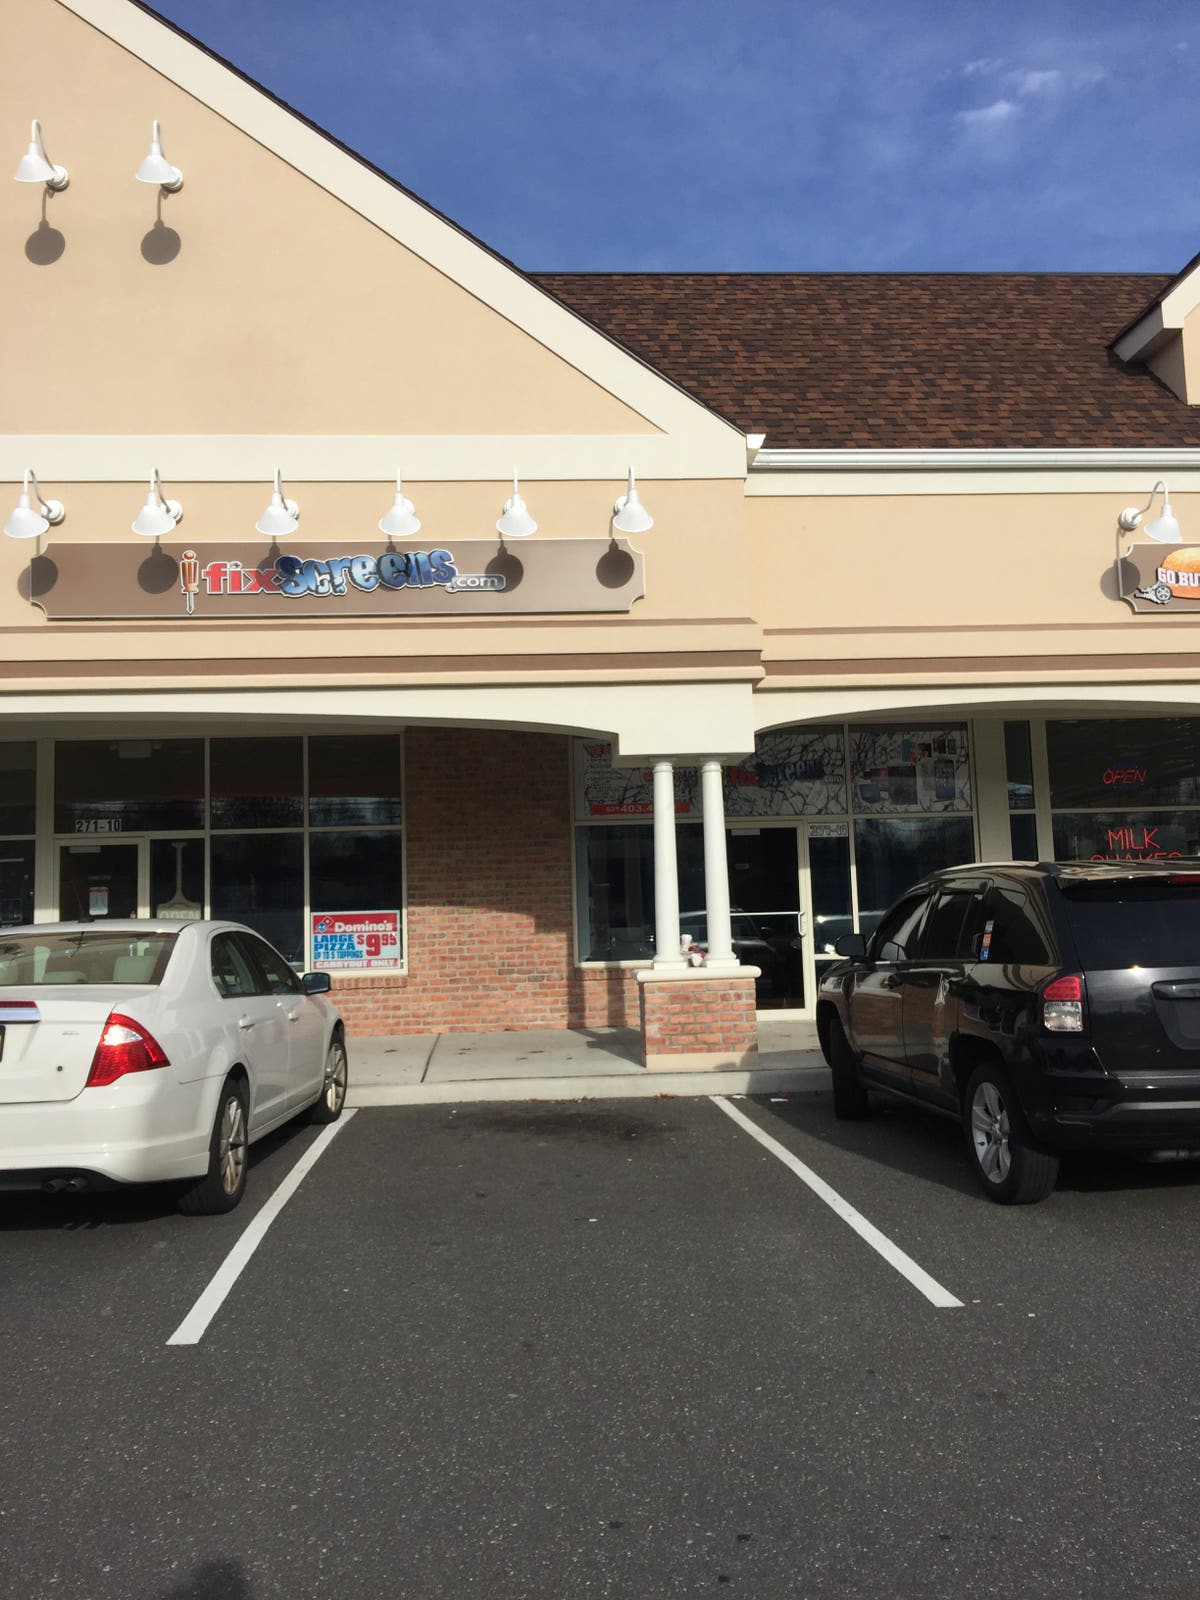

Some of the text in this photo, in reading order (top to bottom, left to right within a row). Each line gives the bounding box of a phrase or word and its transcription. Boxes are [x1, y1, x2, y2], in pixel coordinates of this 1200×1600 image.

[1158, 567, 1200, 588] GO BU
[1102, 769, 1148, 785] OPEN
[76, 819, 121, 832] 271-10
[1107, 827, 1161, 850] MILK
[334, 920, 393, 933] Domino's
[314, 934, 355, 943] LARGE
[314, 943, 355, 951] PIZZA
